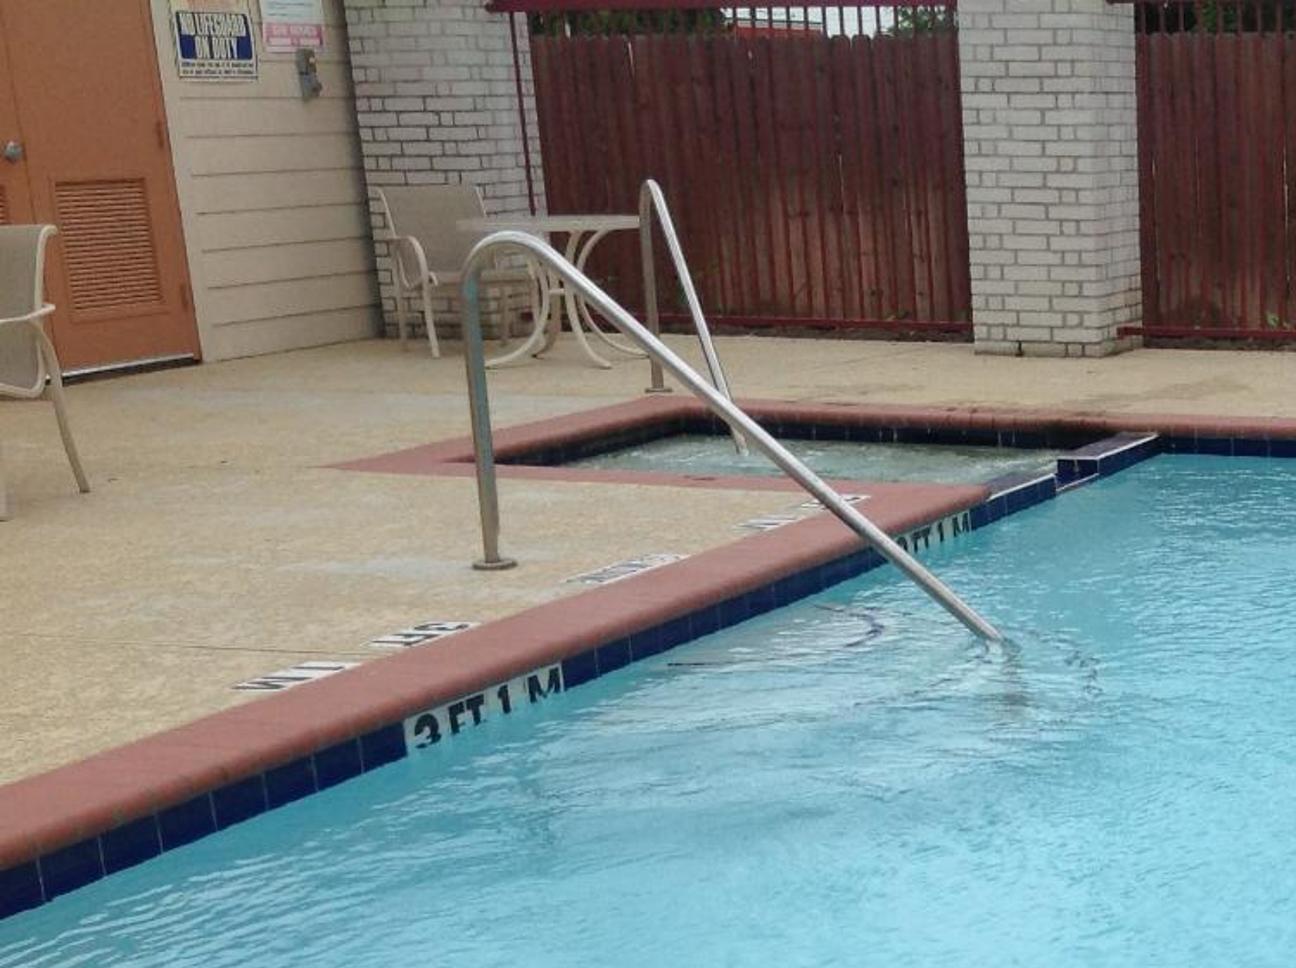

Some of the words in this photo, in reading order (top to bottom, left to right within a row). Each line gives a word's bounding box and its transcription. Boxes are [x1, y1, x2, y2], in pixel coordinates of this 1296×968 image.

[195, 36, 211, 59] ON
[212, 37, 238, 59] DUTY
[414, 714, 442, 749] 3
[449, 699, 485, 735] FT
[498, 685, 511, 714] 1
[526, 667, 560, 704] M
